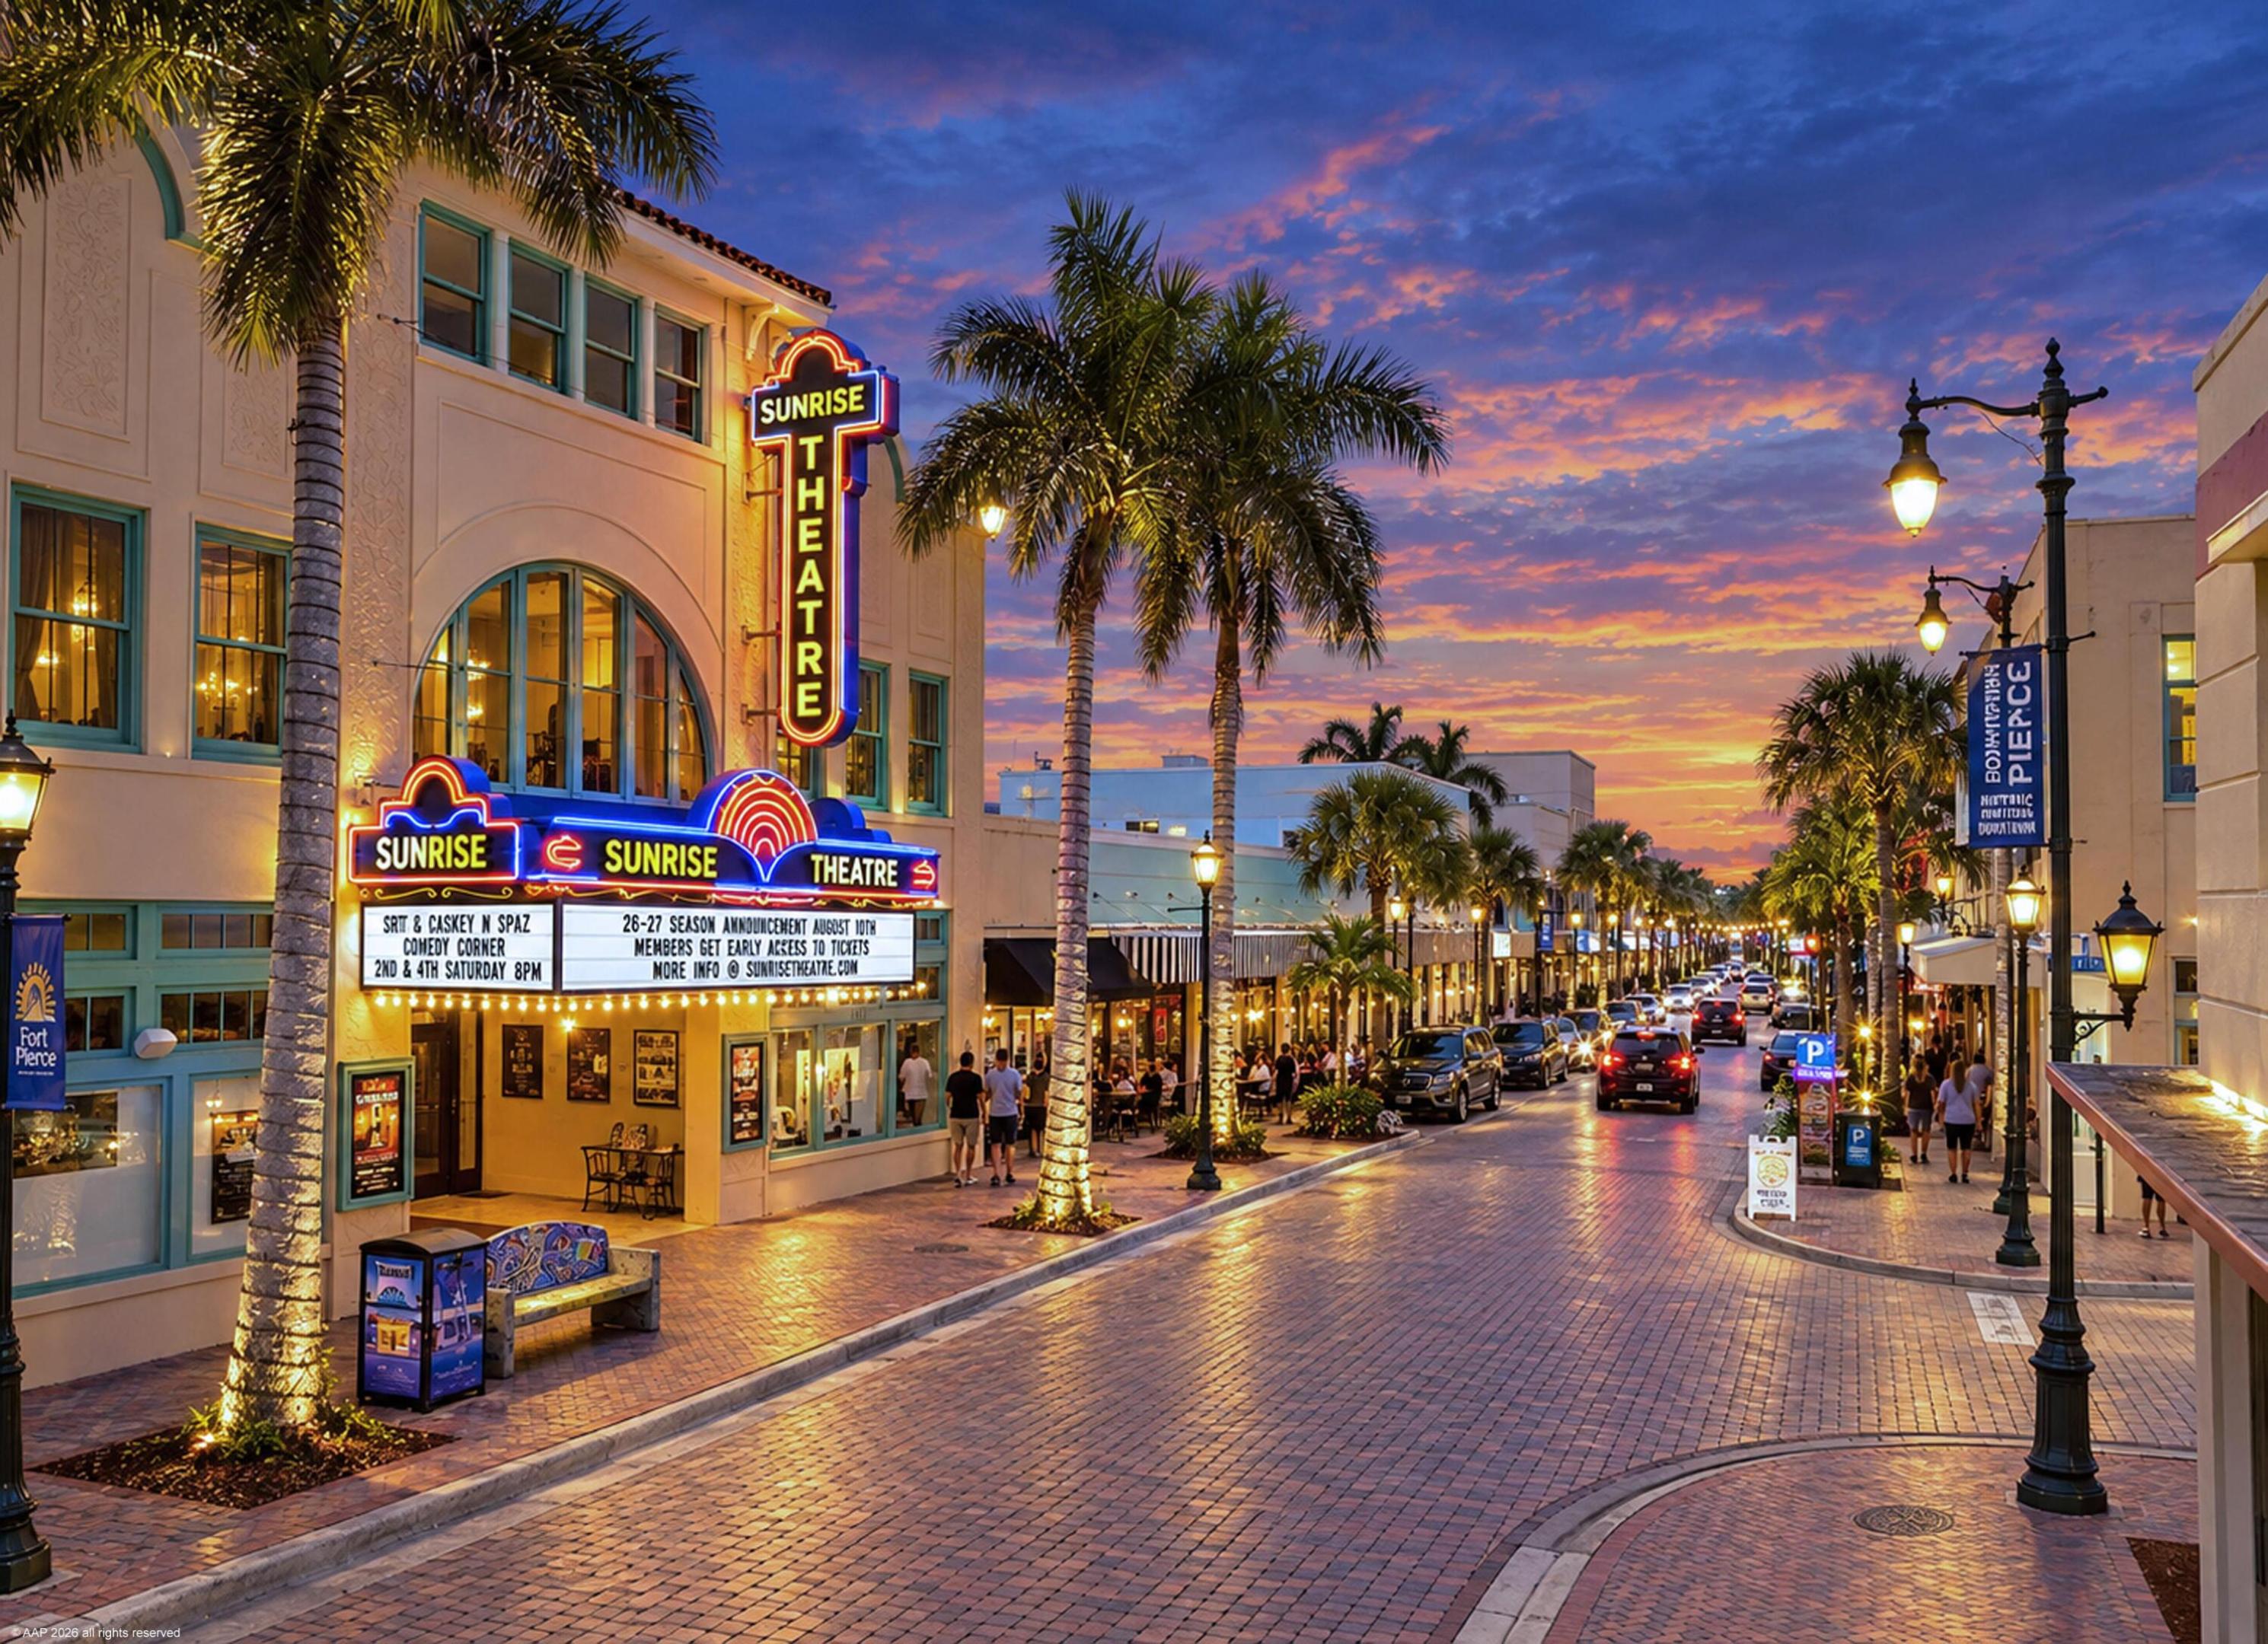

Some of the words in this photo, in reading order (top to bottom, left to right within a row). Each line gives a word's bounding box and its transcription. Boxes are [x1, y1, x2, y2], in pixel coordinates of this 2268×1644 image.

[761, 385, 864, 424] SUNRISE
[796, 435, 824, 717] THEATRE
[375, 834, 486, 870] SUNRISE
[604, 839, 718, 879] SUNRISE
[811, 854, 898, 887] THEATRE
[413, 915, 422, 933] &
[429, 914, 475, 933] CASKEY
[482, 914, 491, 933] N
[498, 914, 531, 933] SPAZ
[623, 914, 662, 933] 26-27
[670, 915, 716, 934] SEASON
[723, 916, 808, 935] ANNOUNCEMENT
[813, 918, 851, 935] AUGUST
[856, 919, 876, 935] 10TH
[404, 938, 450, 956] COMEDY
[457, 938, 505, 957] CORNER
[634, 938, 693, 957] MEMBERS
[700, 938, 722, 957] GET
[727, 938, 761, 957] EARLY
[767, 939, 808, 956] ACCESS
[813, 939, 825, 956] TO
[831, 939, 870, 955] TICKETS
[374, 960, 397, 978] 2ND
[403, 960, 412, 979] &
[417, 960, 439, 979] 4TH
[445, 961, 507, 980] SATURDAY
[515, 961, 542, 981] 8PM
[653, 961, 686, 980] MORE
[694, 961, 719, 979] INFO
[727, 960, 739, 979] @
[21, 1027, 48, 1048] Fort
[15, 1047, 57, 1066] Pierce
[1807, 1040, 1824, 1063] P
[1853, 1129, 1865, 1144] P
